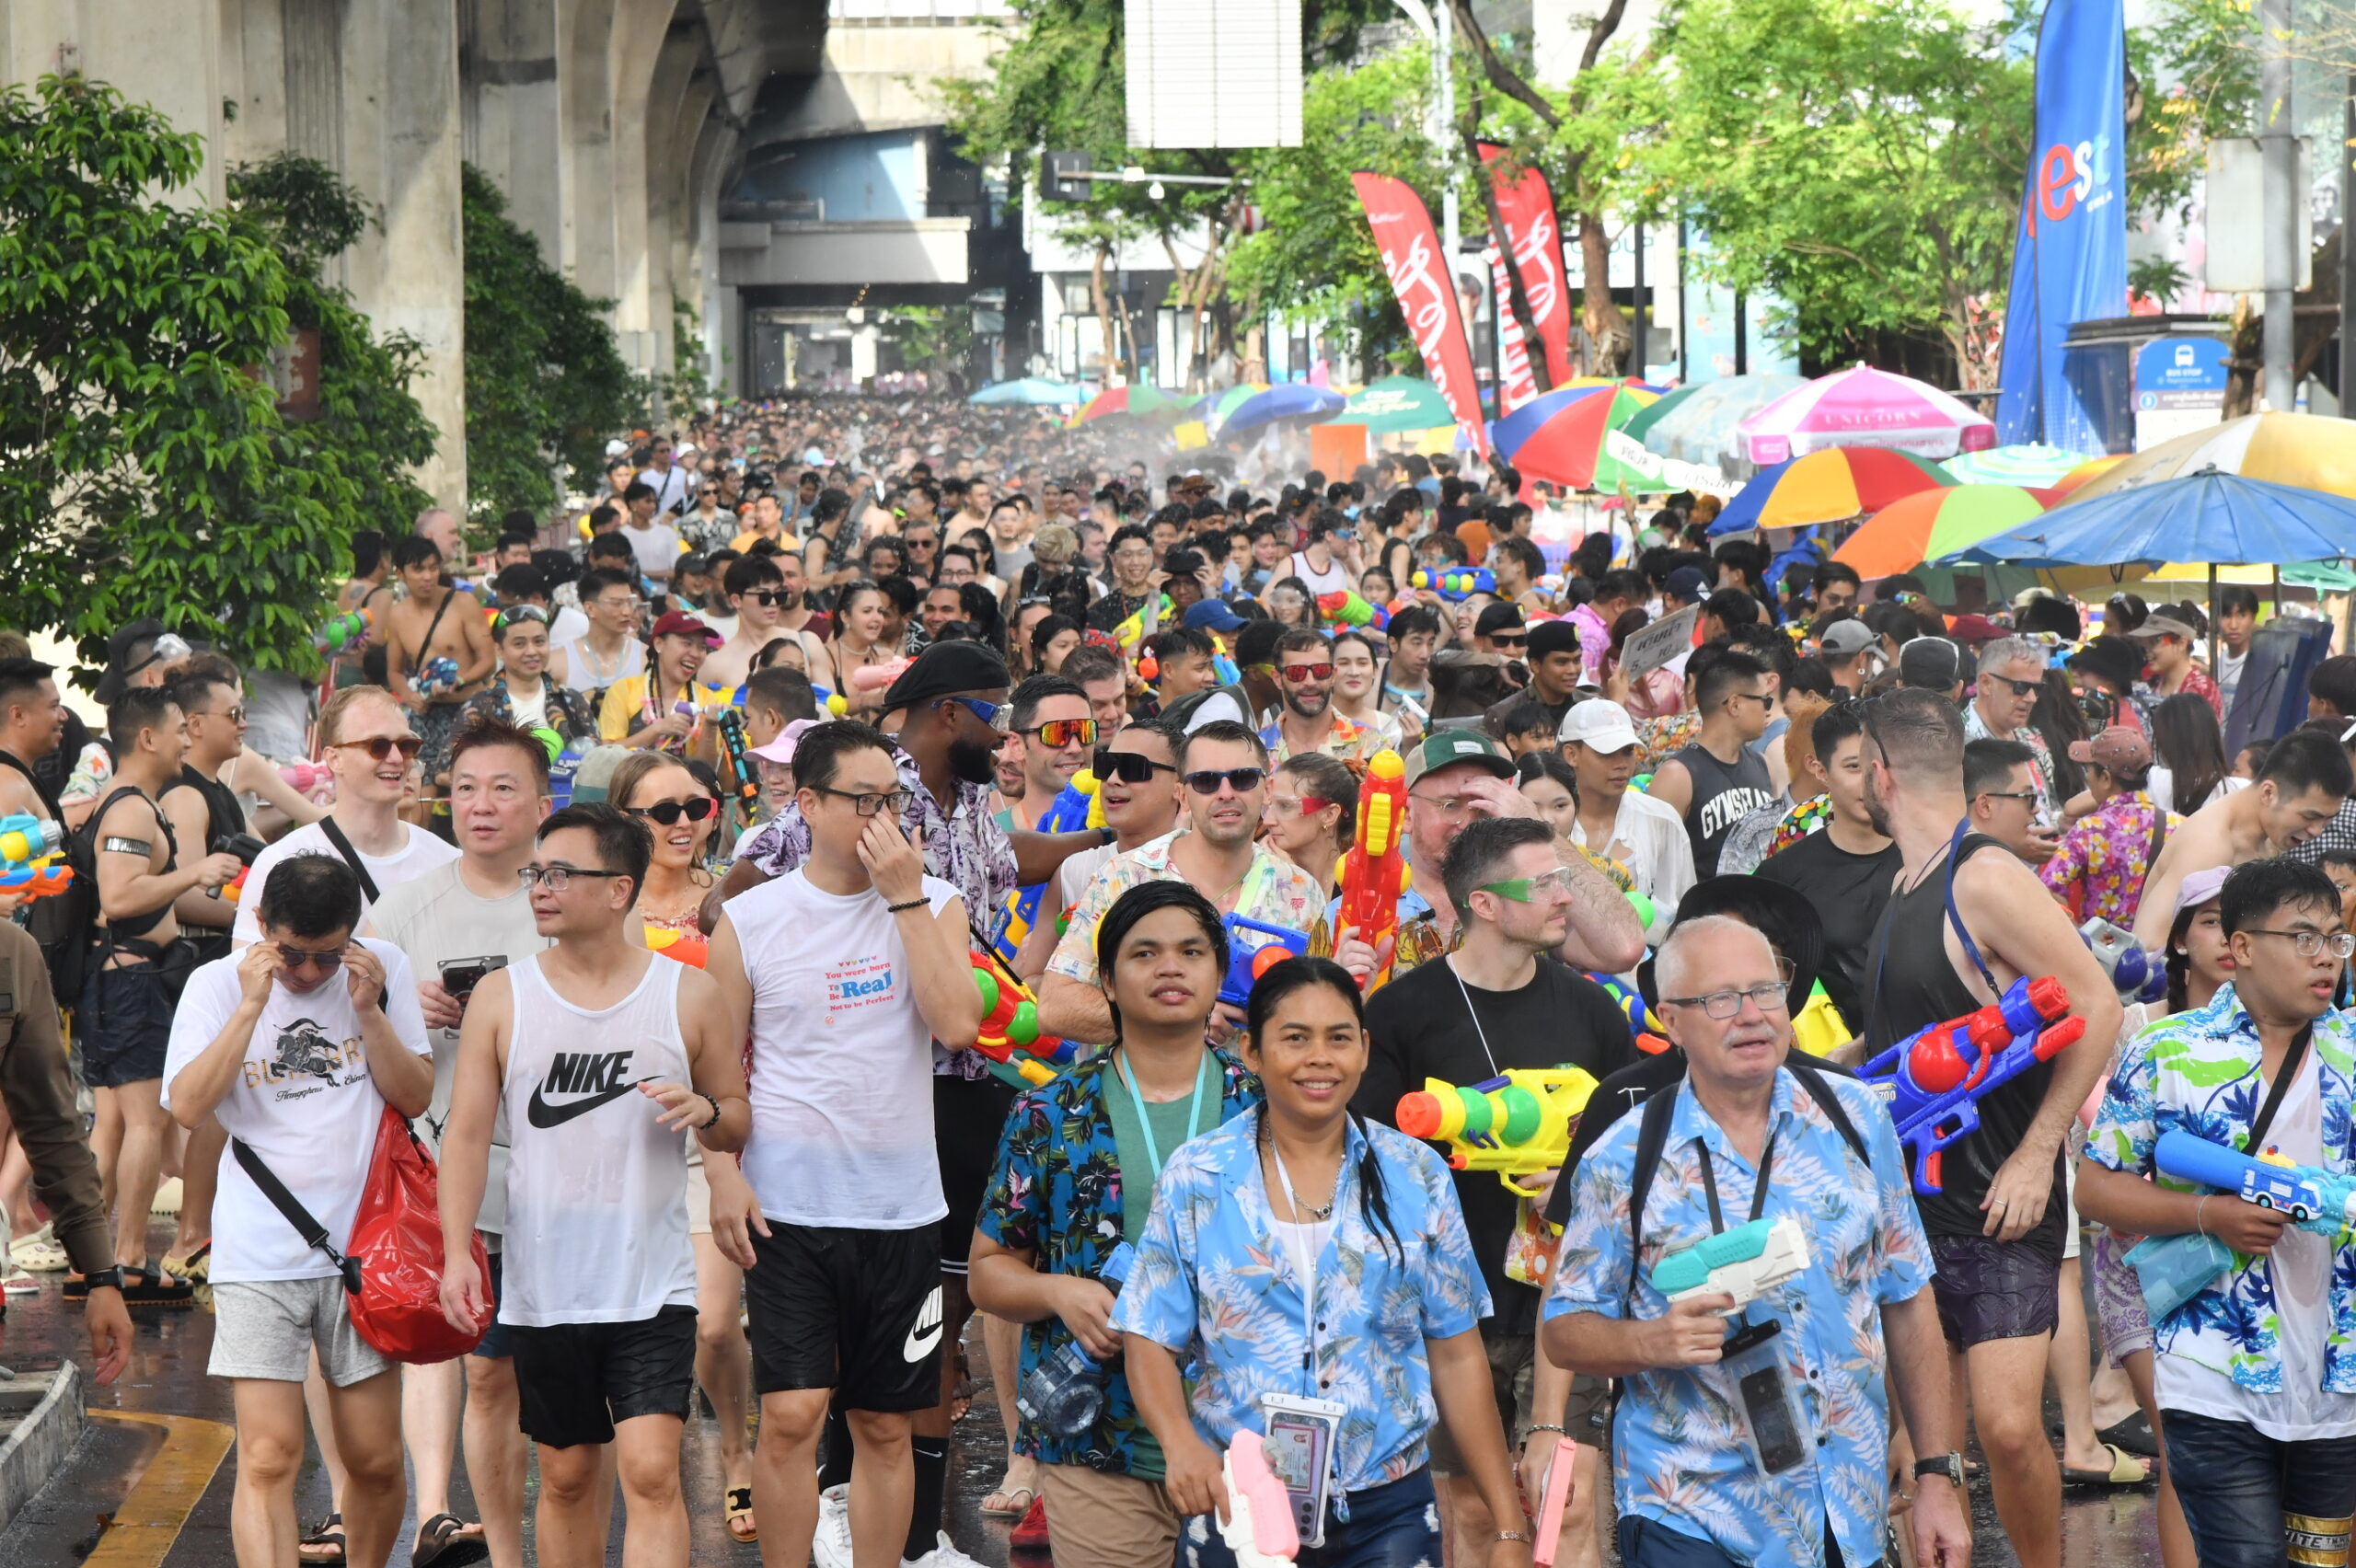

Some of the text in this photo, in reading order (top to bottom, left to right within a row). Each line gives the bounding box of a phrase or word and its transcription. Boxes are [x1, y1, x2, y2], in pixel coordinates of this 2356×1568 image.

[2039, 133, 2111, 221] est
[841, 969, 892, 998] Real
[844, 968, 866, 977] were
[869, 962, 891, 972] born
[544, 1050, 634, 1093] NIKE
